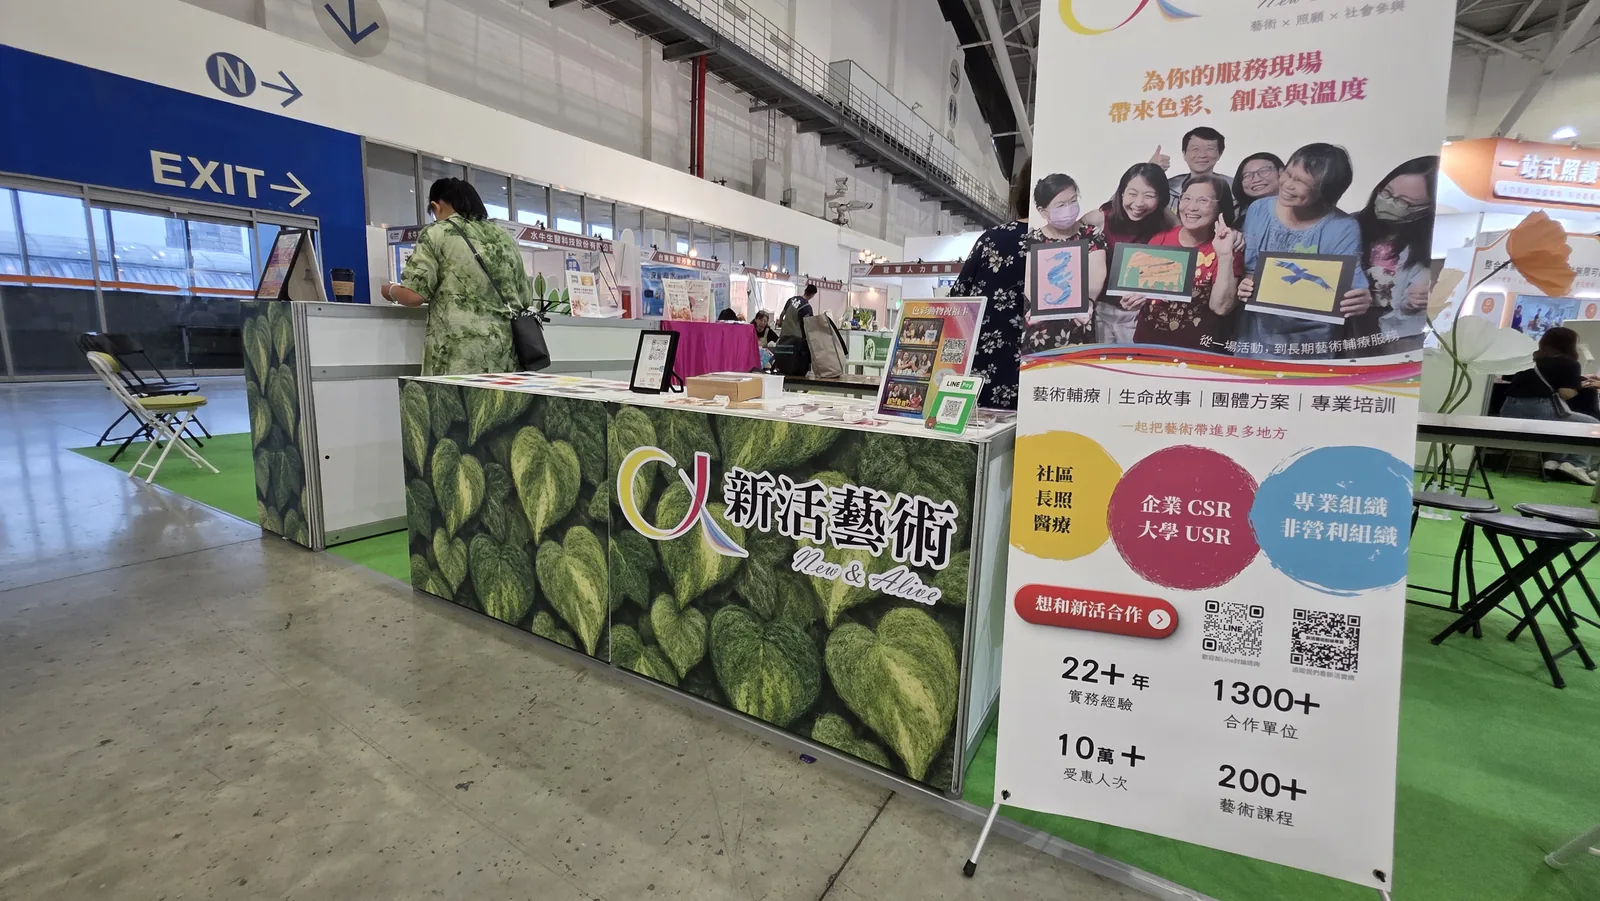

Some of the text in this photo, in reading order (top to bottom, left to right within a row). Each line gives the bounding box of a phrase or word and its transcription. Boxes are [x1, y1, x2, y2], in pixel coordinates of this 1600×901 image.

[1295, 11, 1325, 27] 照顧
[216, 55, 247, 94] N
[1142, 50, 1323, 93] 為你的服務現場
[150, 150, 265, 199] EXIT
[946, 380, 974, 390] LINE Pay
[1033, 386, 1396, 415] 藝術輔療 生命故事 團體方案 專業培訓
[1120, 420, 1288, 441] 一起把藝術帶進更多地方
[1036, 464, 1074, 484] 社區
[1035, 489, 1073, 509] 長照
[1139, 494, 1232, 519] 企業 CSR
[1293, 491, 1388, 518] 專業組織
[725, 469, 956, 569] 新活藝術
[1034, 514, 1072, 535] 醫療
[1137, 519, 1231, 546] 大學 USR
[1280, 517, 1398, 547] 非營利組織
[794, 549, 940, 602] New & Alive
[1035, 594, 1143, 624] 想和新活合作
[1223, 624, 1243, 633] LINE
[1061, 656, 1150, 691] 22+ 年
[1068, 688, 1134, 712] 實務經驗
[1214, 679, 1320, 715] 1300+
[1223, 714, 1299, 740] 合作單位
[1063, 767, 1129, 791] 受惠人次
[1218, 764, 1307, 801] 200+
[1219, 798, 1295, 828] 藝術課程
